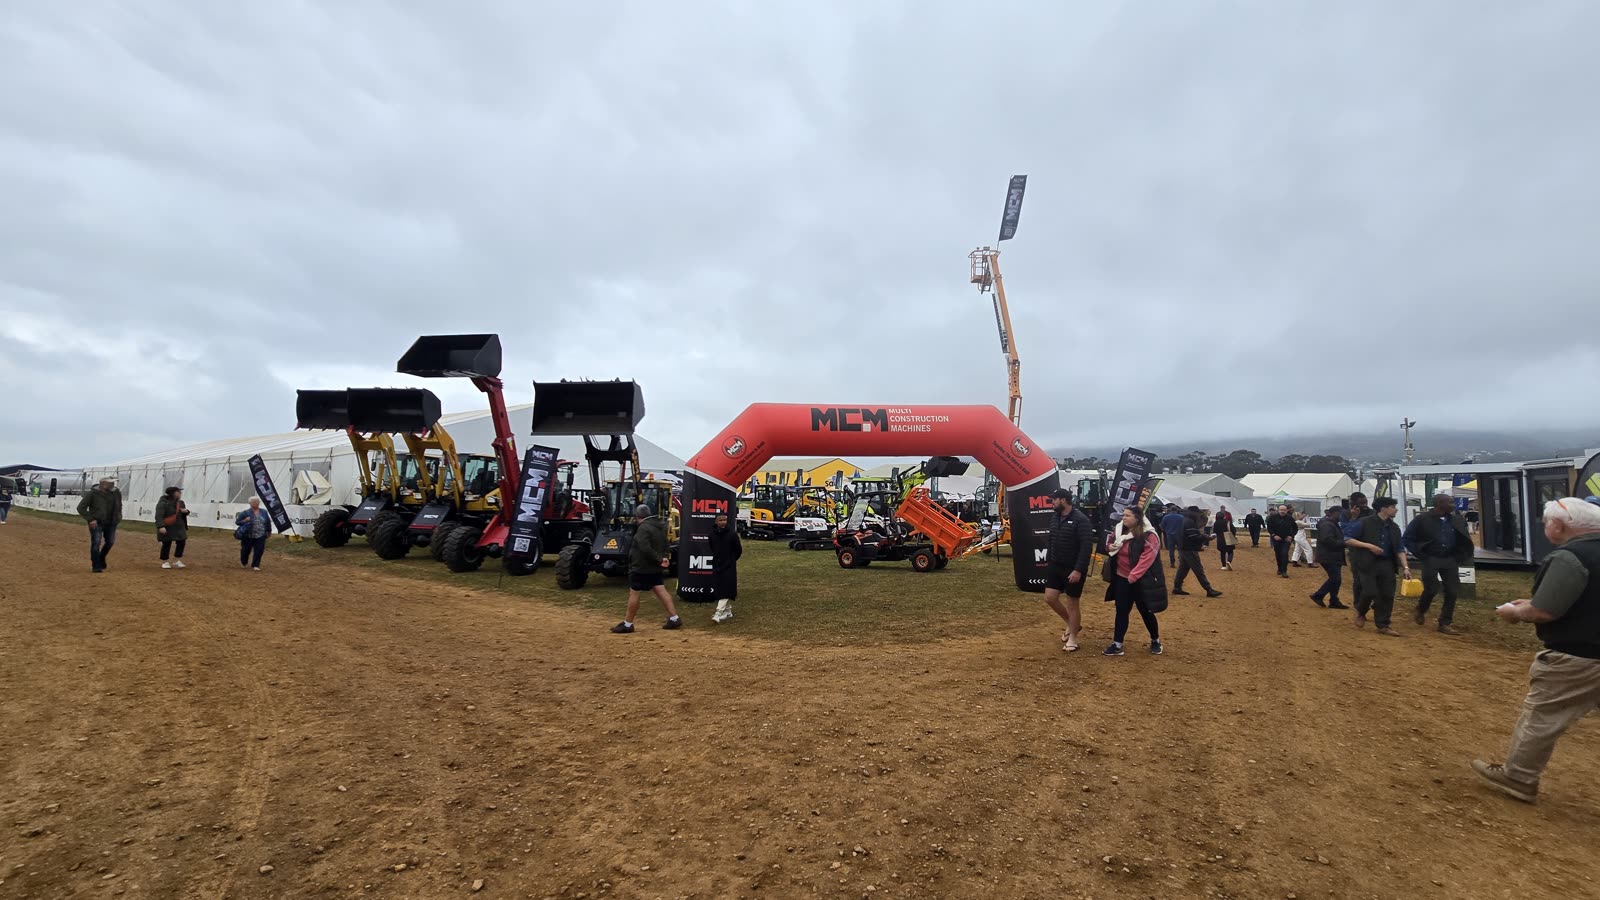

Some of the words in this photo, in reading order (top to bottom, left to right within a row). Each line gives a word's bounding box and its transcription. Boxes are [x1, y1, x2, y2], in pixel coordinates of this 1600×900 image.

[811, 407, 889, 432] MCM
[891, 424, 931, 432] MACHINES
[532, 450, 554, 460] MCM
[1127, 453, 1148, 465] MCM
[518, 467, 550, 523] MCM
[1028, 495, 1054, 509] MC
[692, 499, 729, 513] MCM
